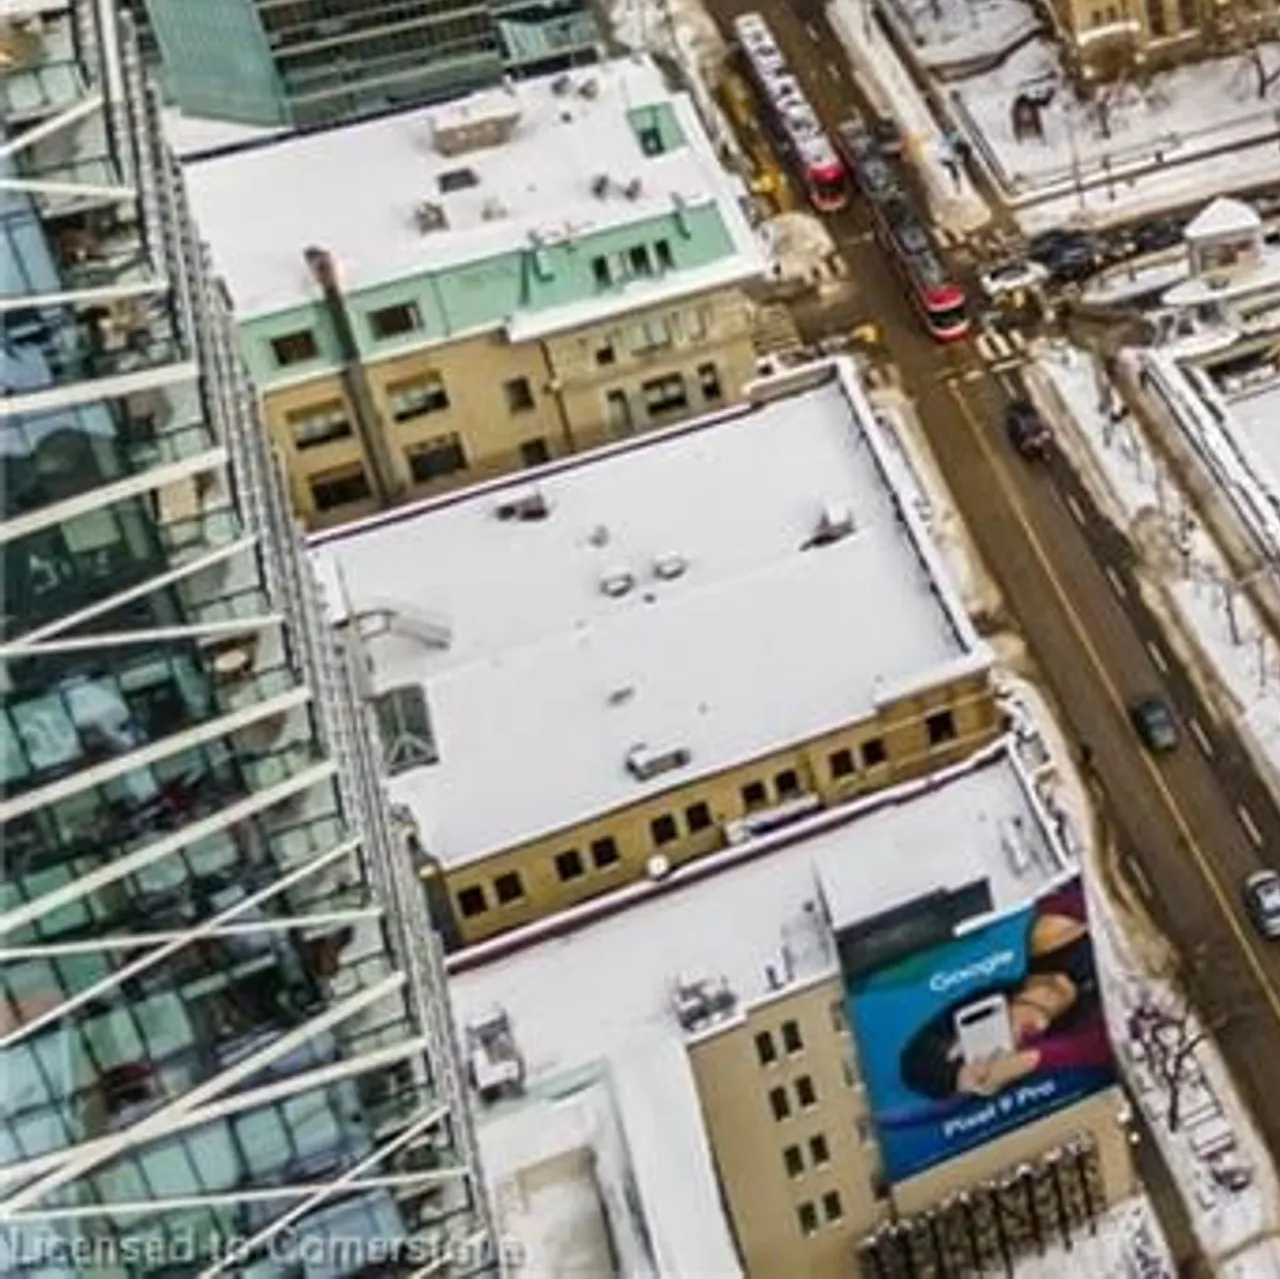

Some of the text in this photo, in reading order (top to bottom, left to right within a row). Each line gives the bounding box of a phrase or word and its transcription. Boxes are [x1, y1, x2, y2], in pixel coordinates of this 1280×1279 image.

[929, 949, 1015, 993] Google
[943, 1103, 996, 1138] Pixel
[1016, 1079, 1056, 1107] Pro
